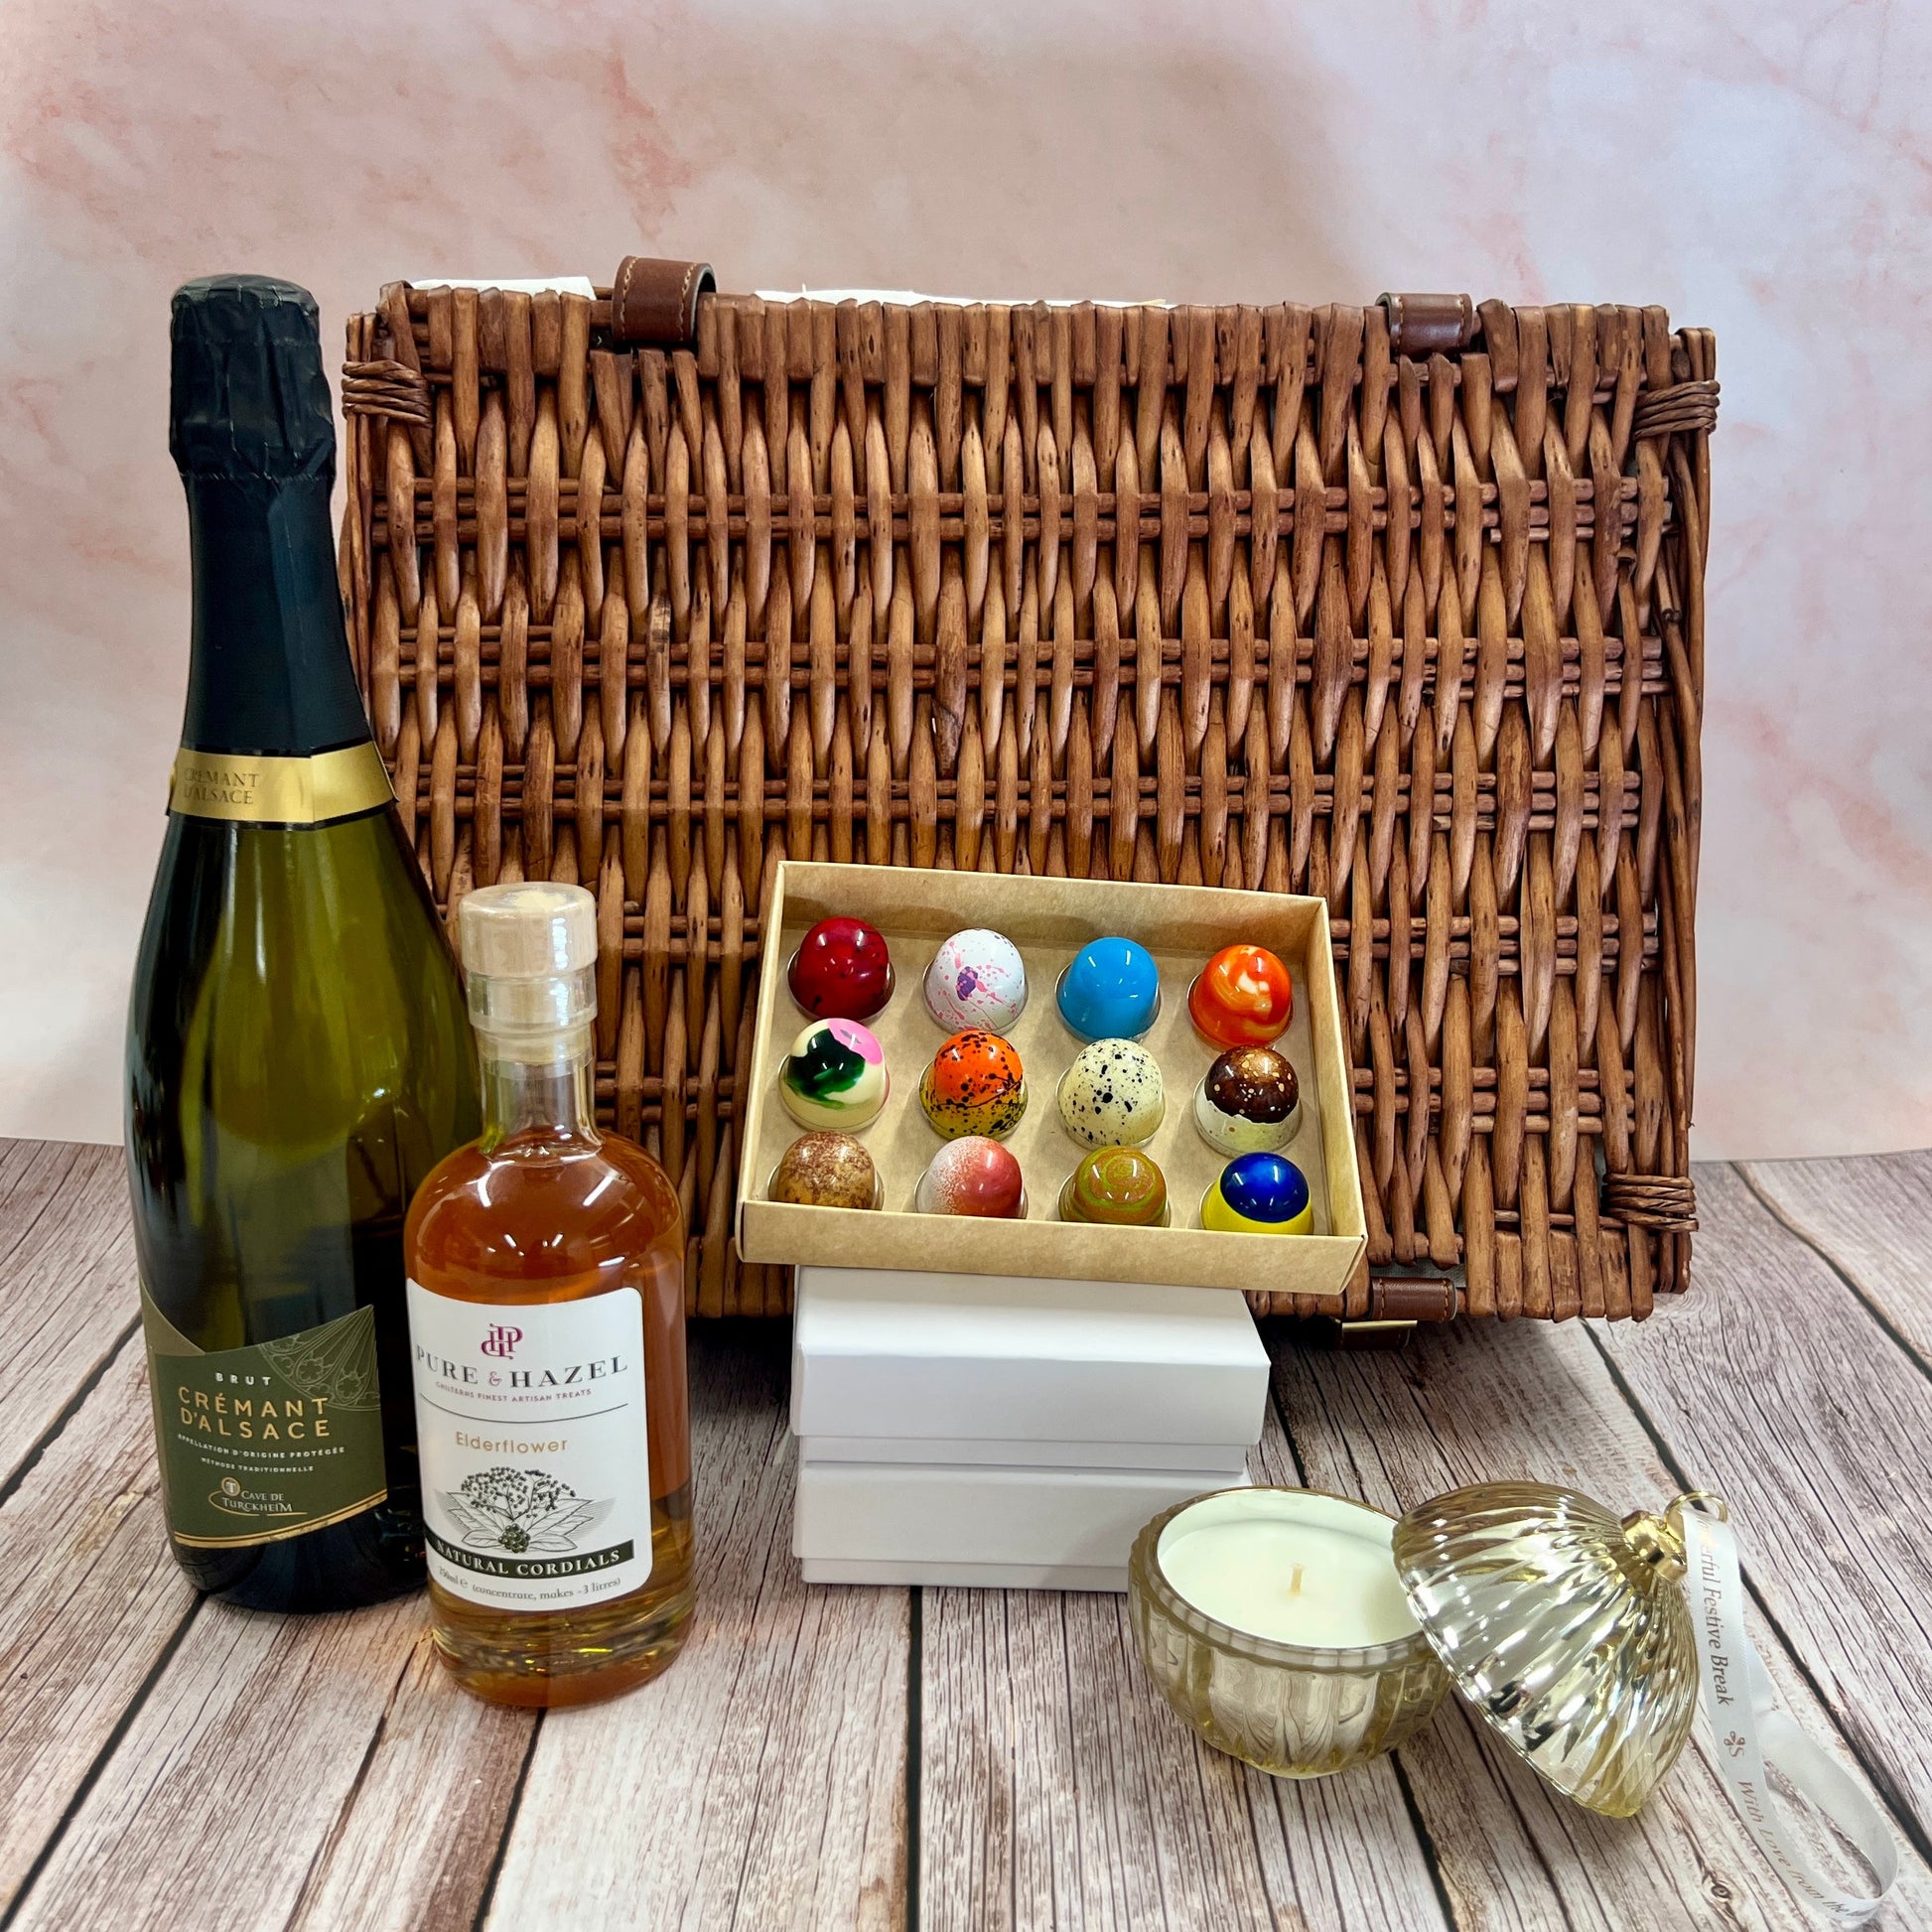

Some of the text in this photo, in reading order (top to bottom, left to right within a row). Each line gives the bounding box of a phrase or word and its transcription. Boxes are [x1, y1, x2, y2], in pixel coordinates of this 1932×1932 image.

[415, 1342, 628, 1389] PURE & HAZEL
[213, 1372, 271, 1386] BRUT
[179, 1386, 329, 1418] CRÉMANT
[478, 1393, 508, 1403] FINEST
[556, 1388, 593, 1400] TREATS
[181, 1406, 331, 1440] D'ALSACE
[178, 1434, 229, 1453] APPELLATION
[289, 1447, 345, 1458] PROTÉGÉE
[456, 1431, 568, 1454] Elderflower
[238, 1464, 314, 1473] TRADITIONNELLE
[221, 1497, 293, 1513] TURCKHEIM
[241, 1490, 285, 1502] CAVE DE
[436, 1541, 621, 1577] NATURAL CORDIALS
[472, 1584, 536, 1601] (concentrate,
[539, 1589, 574, 1600] makes
[592, 1577, 621, 1592] litres)
[1703, 1587, 1724, 1649] Festive
[1711, 1654, 1734, 1707] Break
[1737, 1780, 1764, 1823] With
[1759, 1828, 1791, 1867] Love
[1788, 1868, 1825, 1899] from
